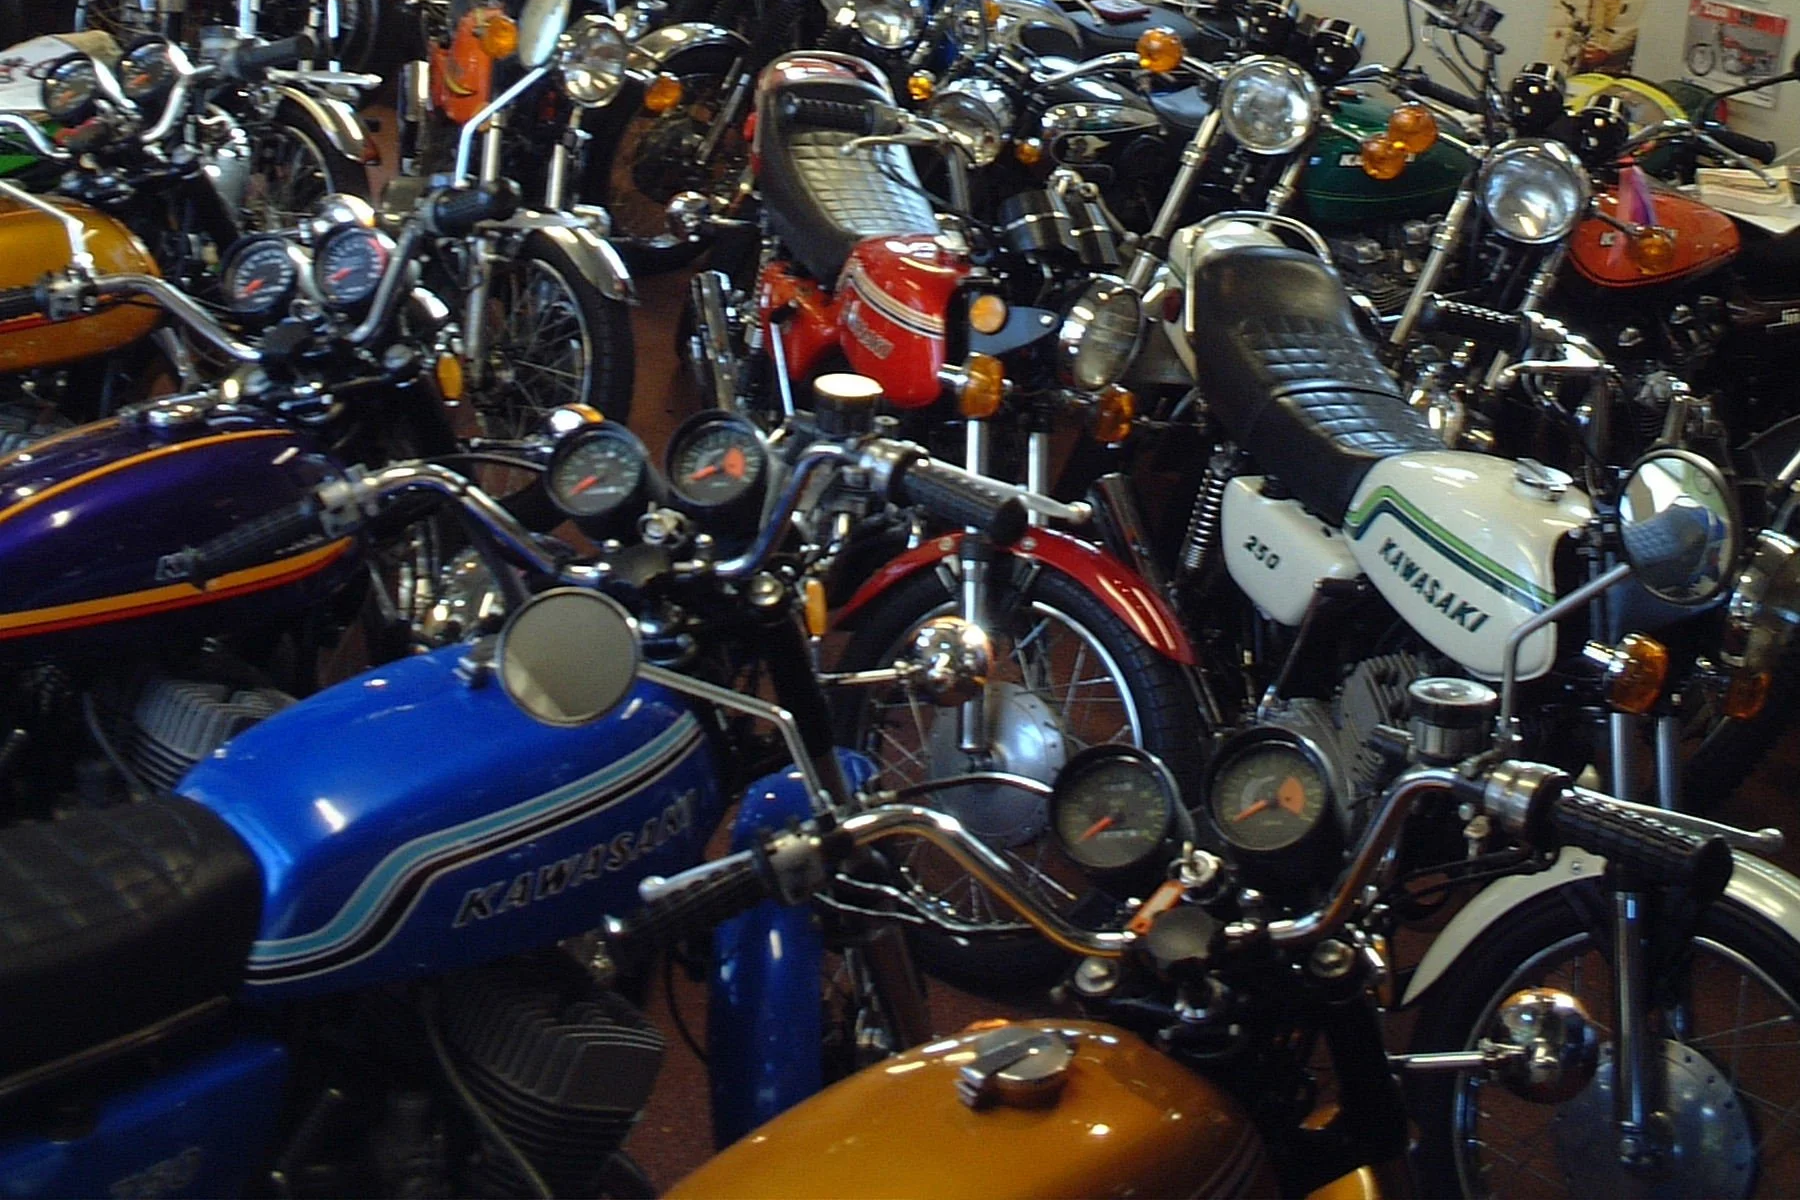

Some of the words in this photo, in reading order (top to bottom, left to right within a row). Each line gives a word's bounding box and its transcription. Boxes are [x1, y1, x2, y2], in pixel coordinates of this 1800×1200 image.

[1242, 535, 1281, 570] 250
[1378, 538, 1491, 633] KAWASAKI
[453, 788, 698, 927] KAWASAKI
